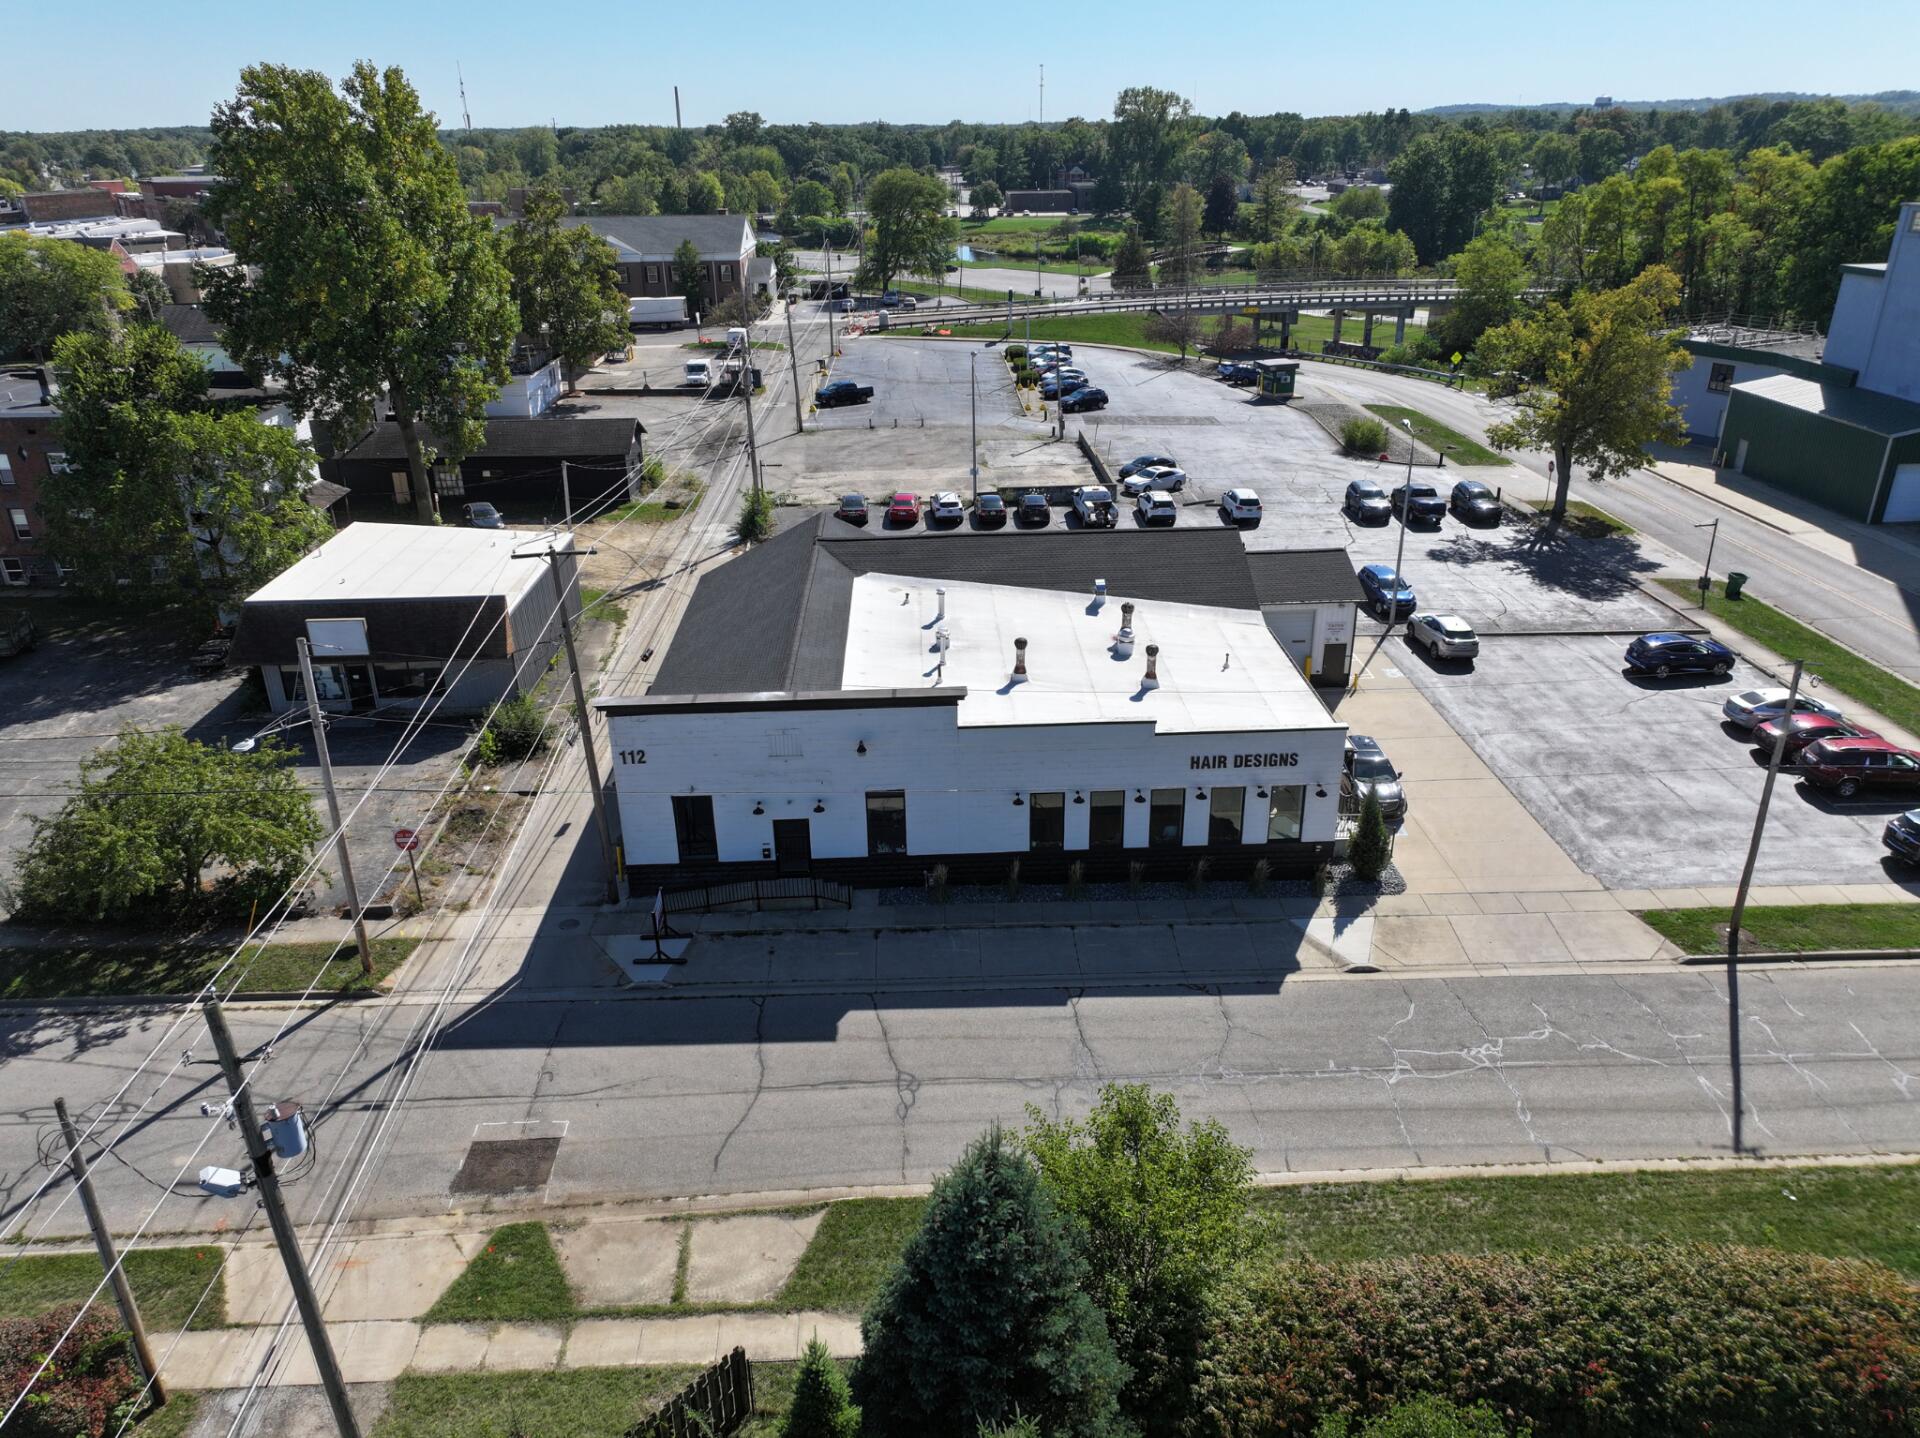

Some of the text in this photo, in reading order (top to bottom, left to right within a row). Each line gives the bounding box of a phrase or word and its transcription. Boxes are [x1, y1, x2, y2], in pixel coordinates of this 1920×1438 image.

[619, 749, 647, 765] 112
[1190, 752, 1299, 770] HAIR DESIGNS
